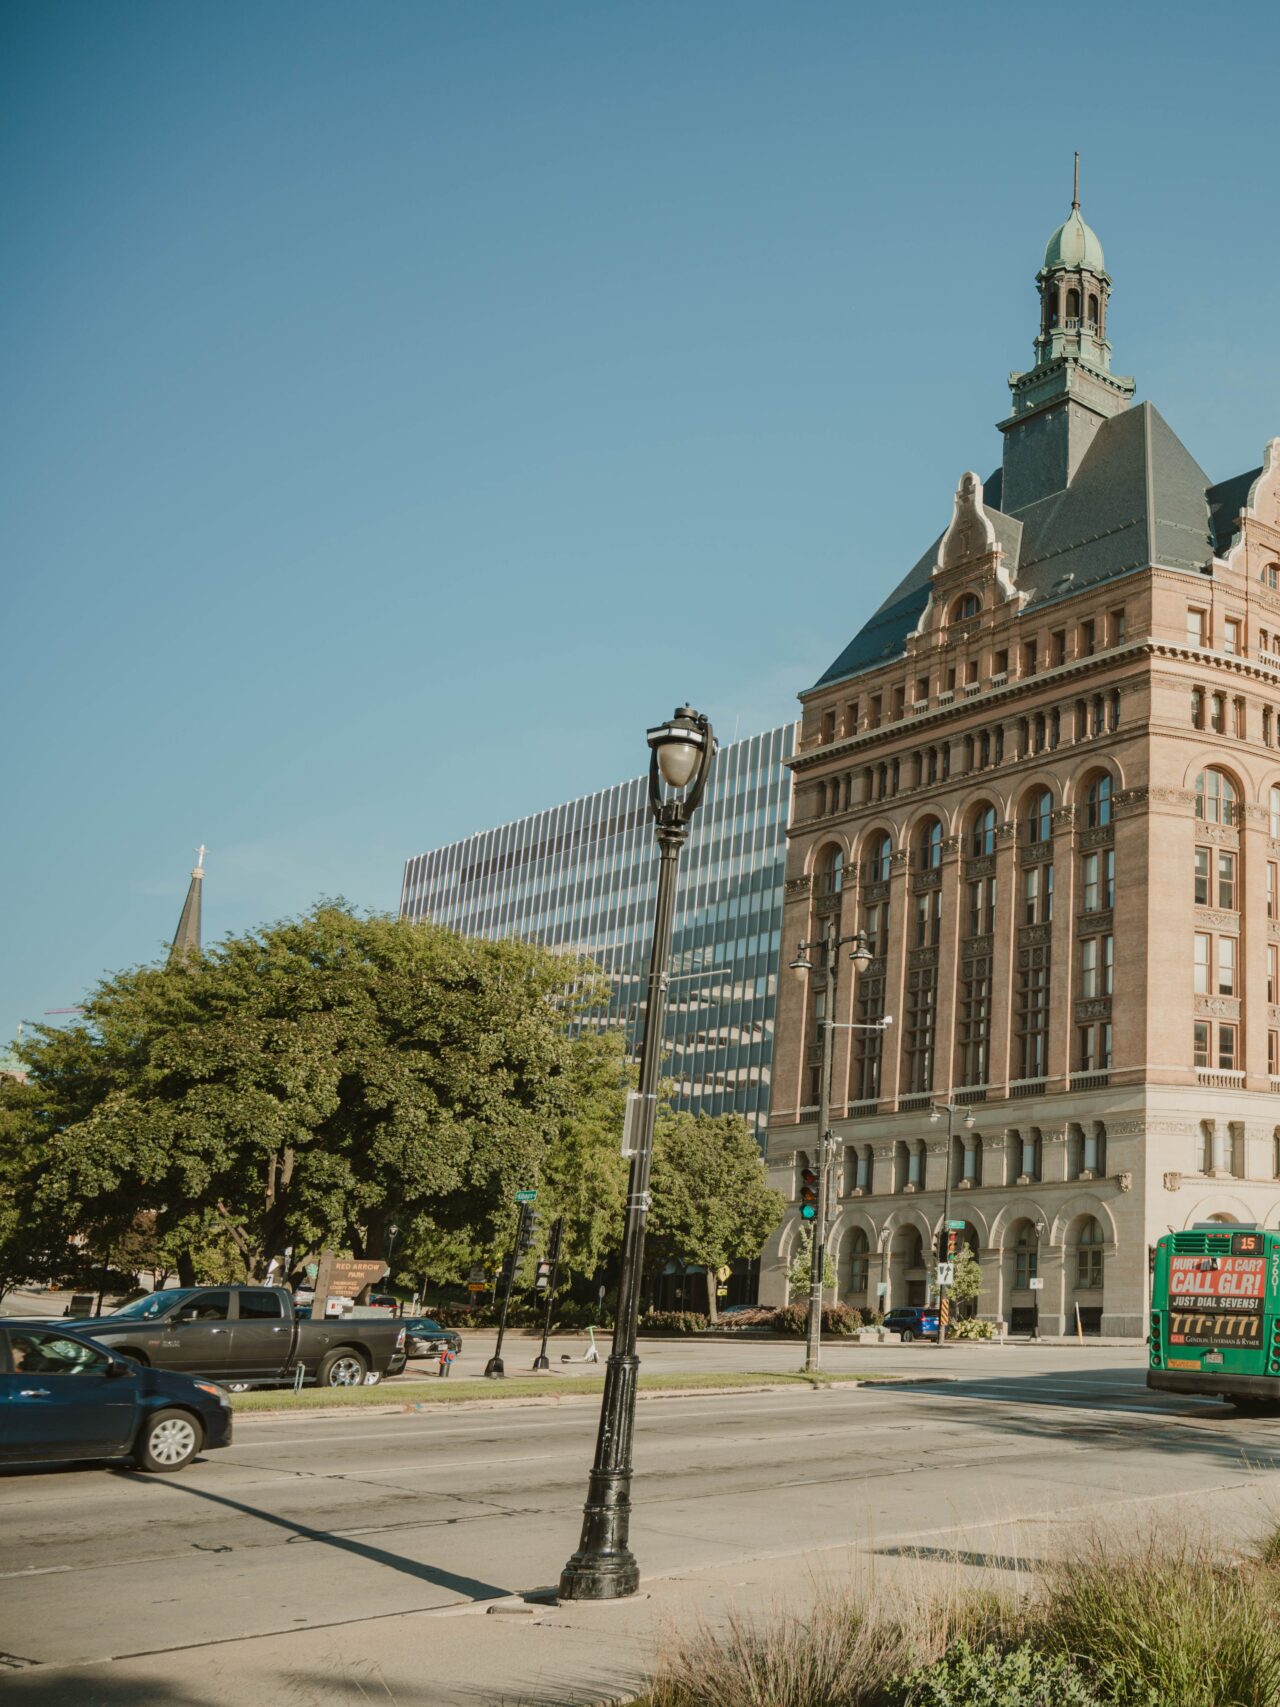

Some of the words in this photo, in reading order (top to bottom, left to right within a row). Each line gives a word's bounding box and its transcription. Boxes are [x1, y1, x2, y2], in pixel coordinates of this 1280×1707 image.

[1241, 1237, 1255, 1250] 15
[352, 1263, 380, 1271] ARROW
[1173, 1258, 1199, 1270] HURT
[1224, 1260, 1233, 1271] A
[1234, 1260, 1263, 1273] CAR?
[347, 1271, 365, 1279] PARK
[1171, 1272, 1215, 1293] CALL
[1217, 1273, 1262, 1295] GLR!
[1173, 1296, 1196, 1306] JUST
[1197, 1298, 1217, 1307] DIAL
[1219, 1298, 1259, 1309] SEVENS!
[1171, 1313, 1259, 1336] 777-7777
